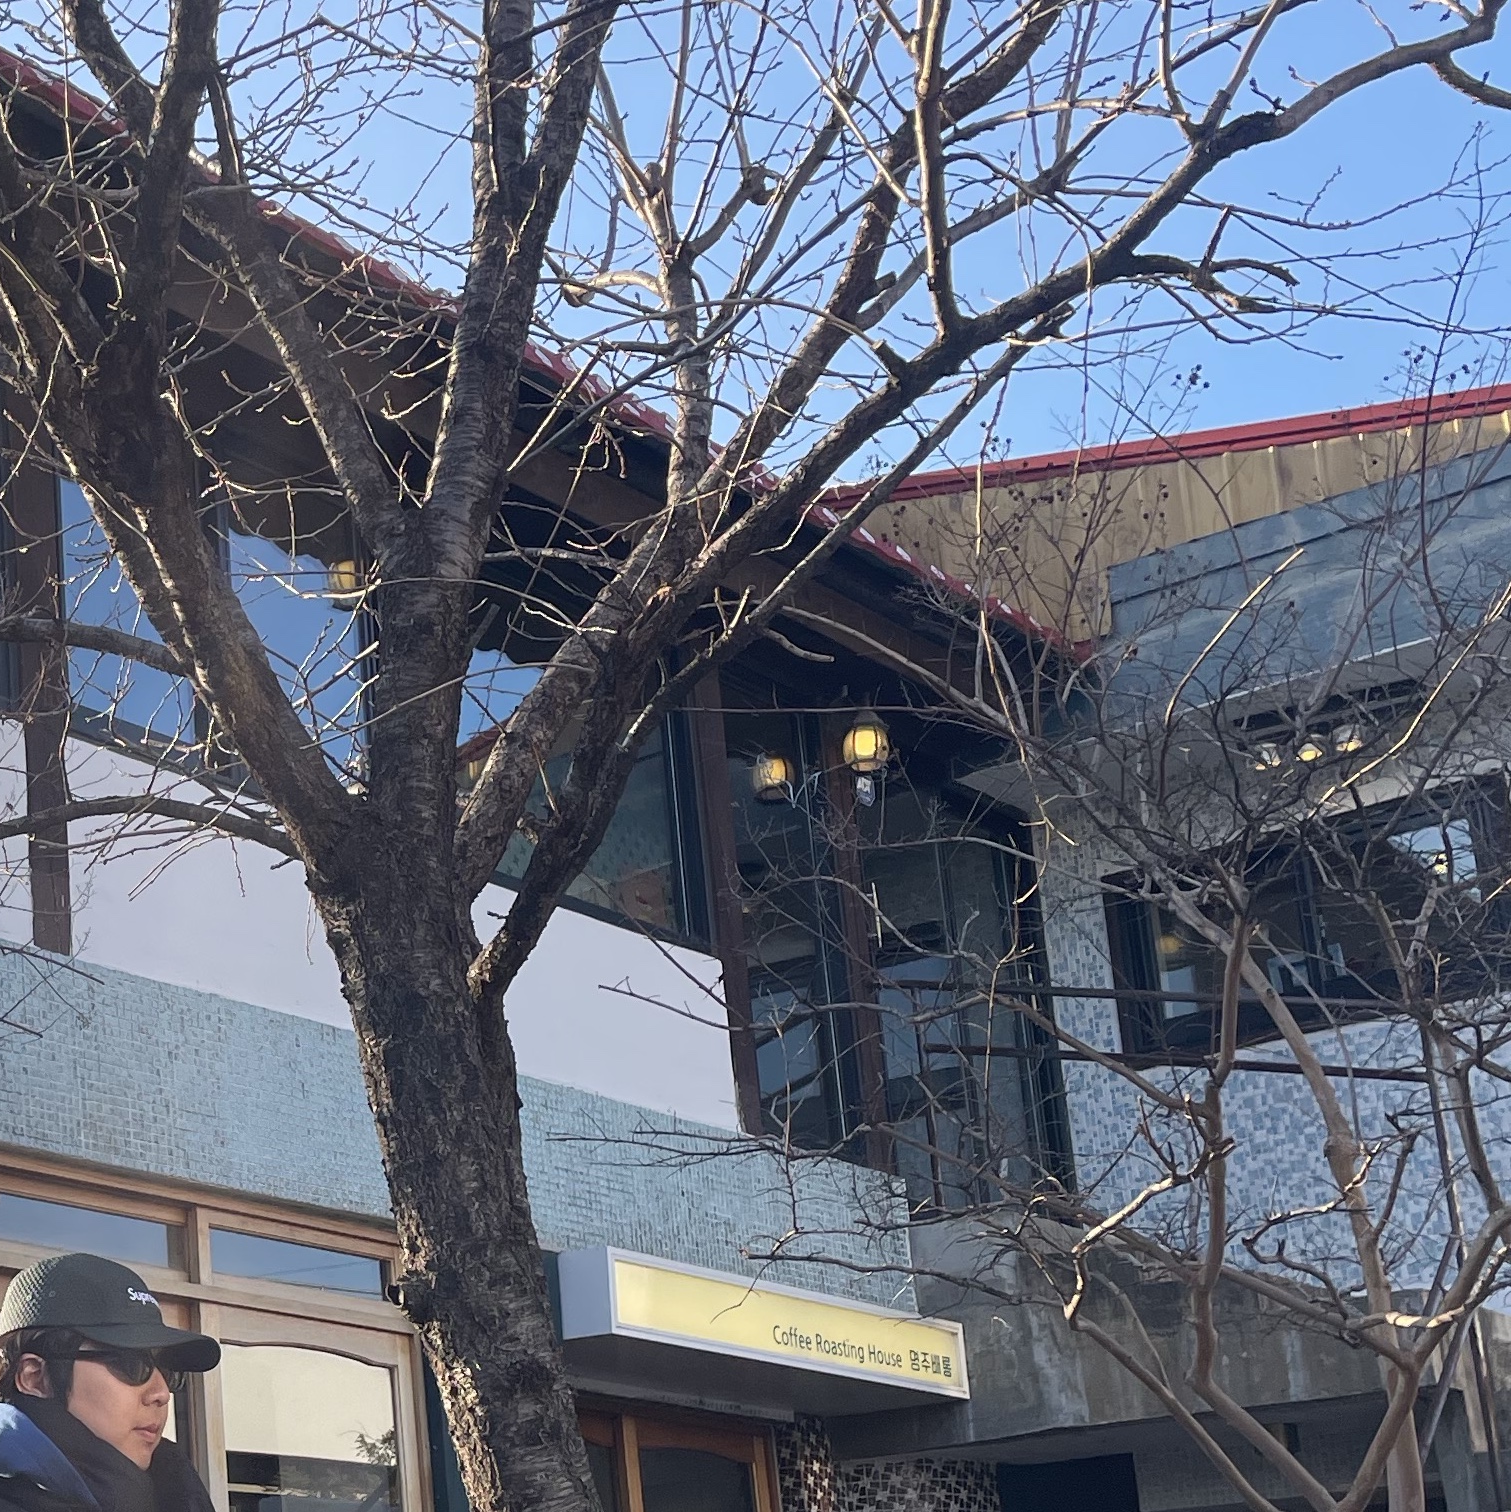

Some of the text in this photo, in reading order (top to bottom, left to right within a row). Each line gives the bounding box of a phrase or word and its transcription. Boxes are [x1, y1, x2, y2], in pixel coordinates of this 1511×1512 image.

[772, 1325, 952, 1378] Coffee Roasting House 명주배롱
